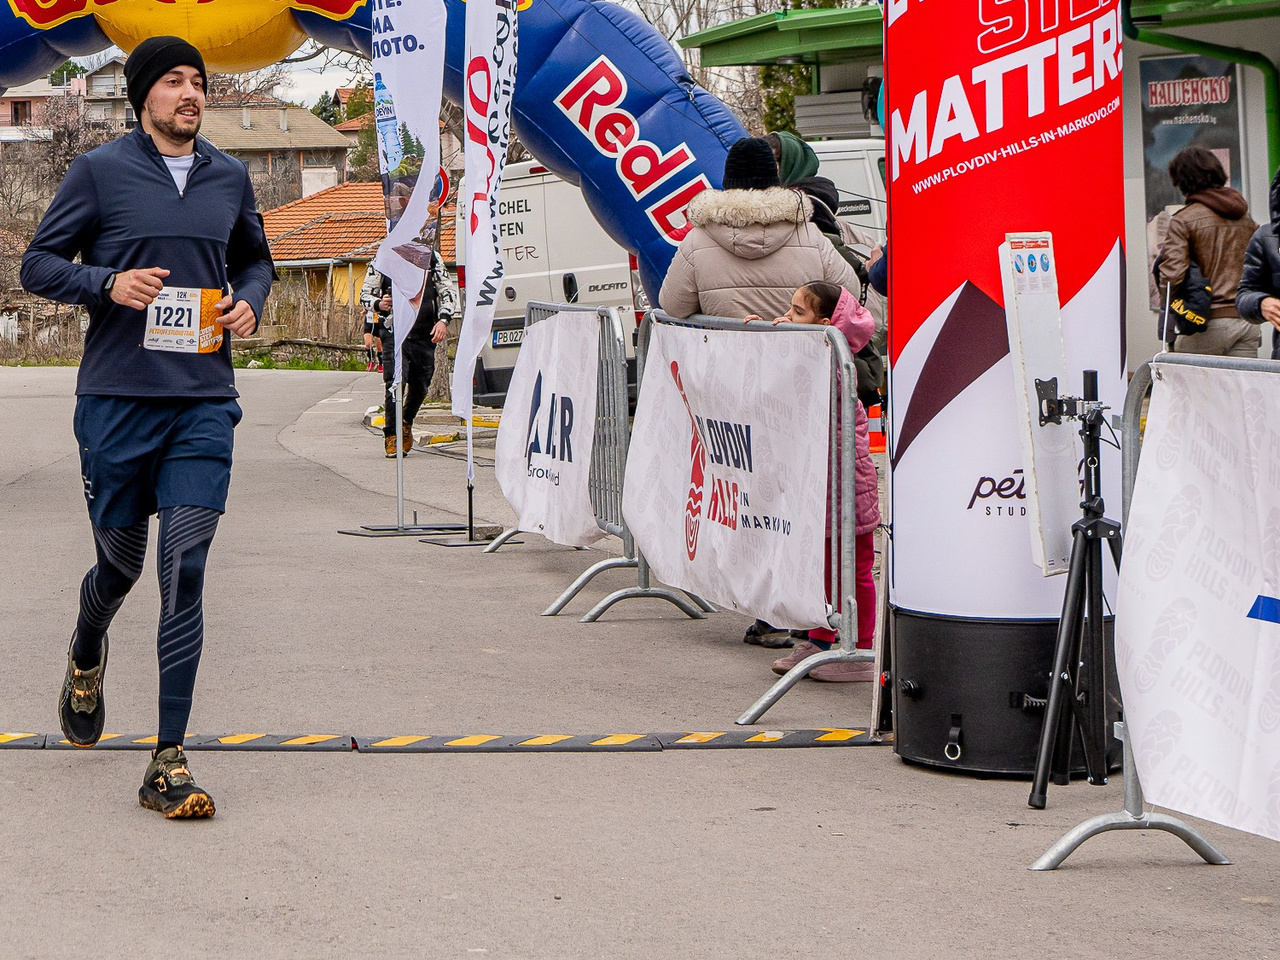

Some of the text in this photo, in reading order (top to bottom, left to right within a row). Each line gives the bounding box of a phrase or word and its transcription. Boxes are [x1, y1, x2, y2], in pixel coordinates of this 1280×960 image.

[559, 60, 690, 195] Red
[912, 96, 1120, 195] WWW.PLOVDIV-HILLS-IN-MARKOVO.COM
[588, 282, 628, 293] DUCATO
[154, 306, 193, 328] 1221
[740, 491, 750, 507] IN
